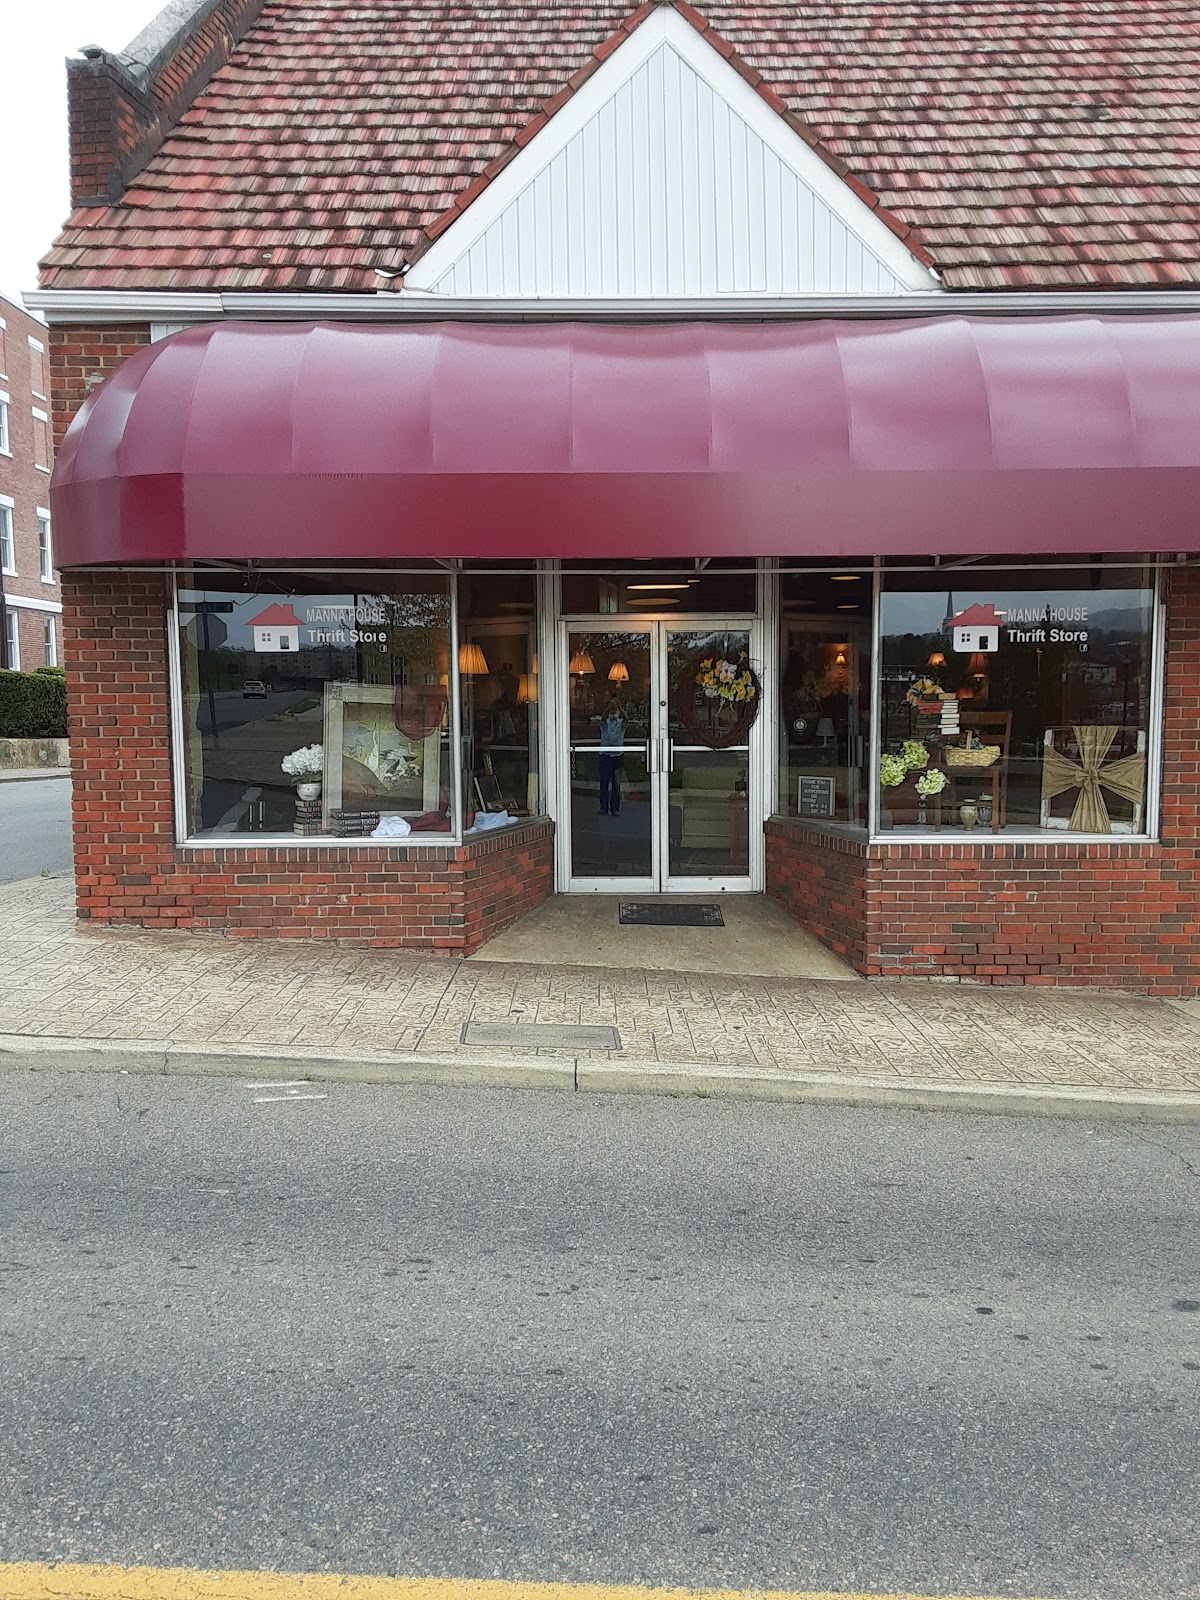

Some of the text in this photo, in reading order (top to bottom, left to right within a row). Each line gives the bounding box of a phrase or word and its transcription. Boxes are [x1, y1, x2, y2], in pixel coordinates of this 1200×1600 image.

[306, 608, 386, 622] MANNA HOUSE
[1007, 607, 1088, 622] MANNA HOUSE
[307, 629, 346, 643] Thrift
[1007, 628, 1088, 643] Thrift Store
